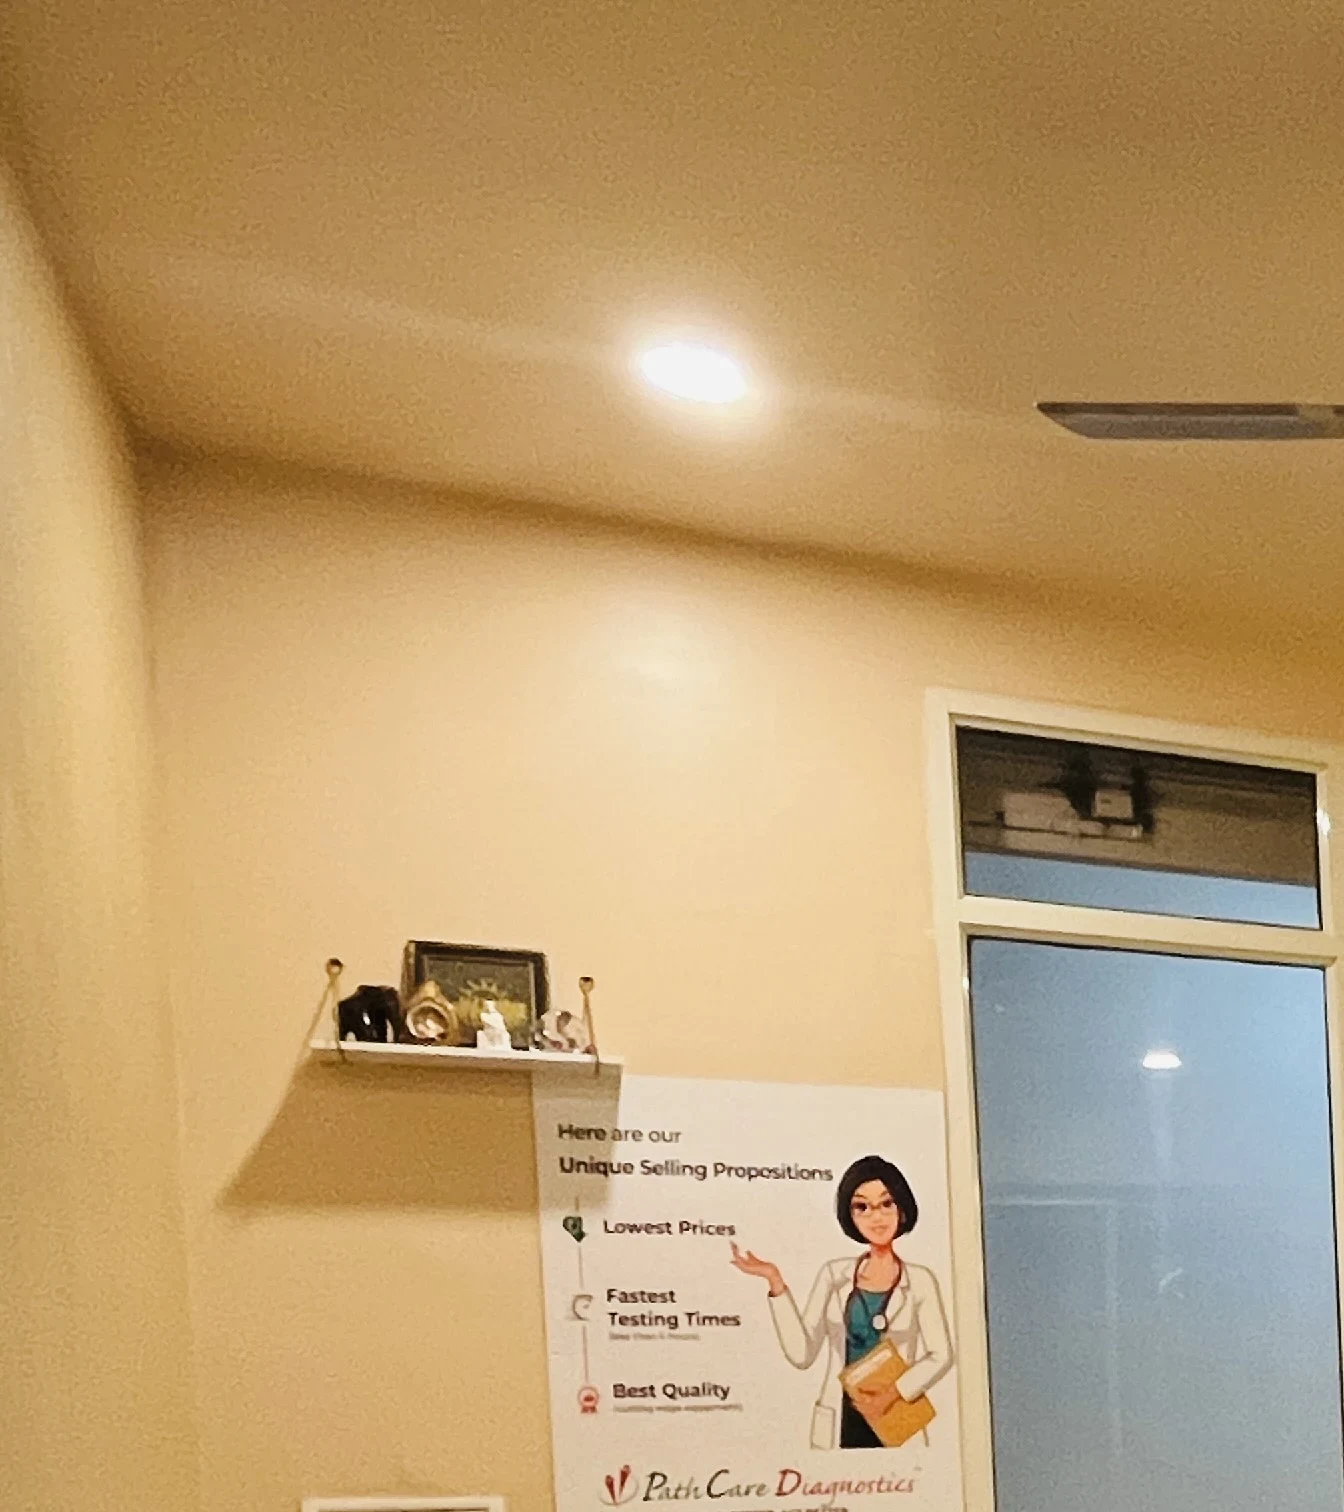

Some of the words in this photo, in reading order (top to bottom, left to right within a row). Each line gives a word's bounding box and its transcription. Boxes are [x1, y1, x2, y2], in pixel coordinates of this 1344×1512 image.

[558, 1123, 607, 1142] Here
[611, 1127, 643, 1142] are
[648, 1129, 682, 1143] our
[559, 1156, 635, 1177] Unique
[640, 1159, 708, 1181] Selling
[713, 1161, 834, 1182] Propositions
[604, 1219, 673, 1235] Lowest
[678, 1220, 736, 1237] Prices
[606, 1288, 677, 1304] Fastest
[608, 1311, 680, 1330] Testing
[684, 1311, 742, 1327] Times
[612, 1383, 656, 1399] Best
[662, 1382, 731, 1401] Quality
[642, 1470, 704, 1502] Path
[705, 1468, 770, 1500] Care
[774, 1468, 916, 1506] Diagnostics
